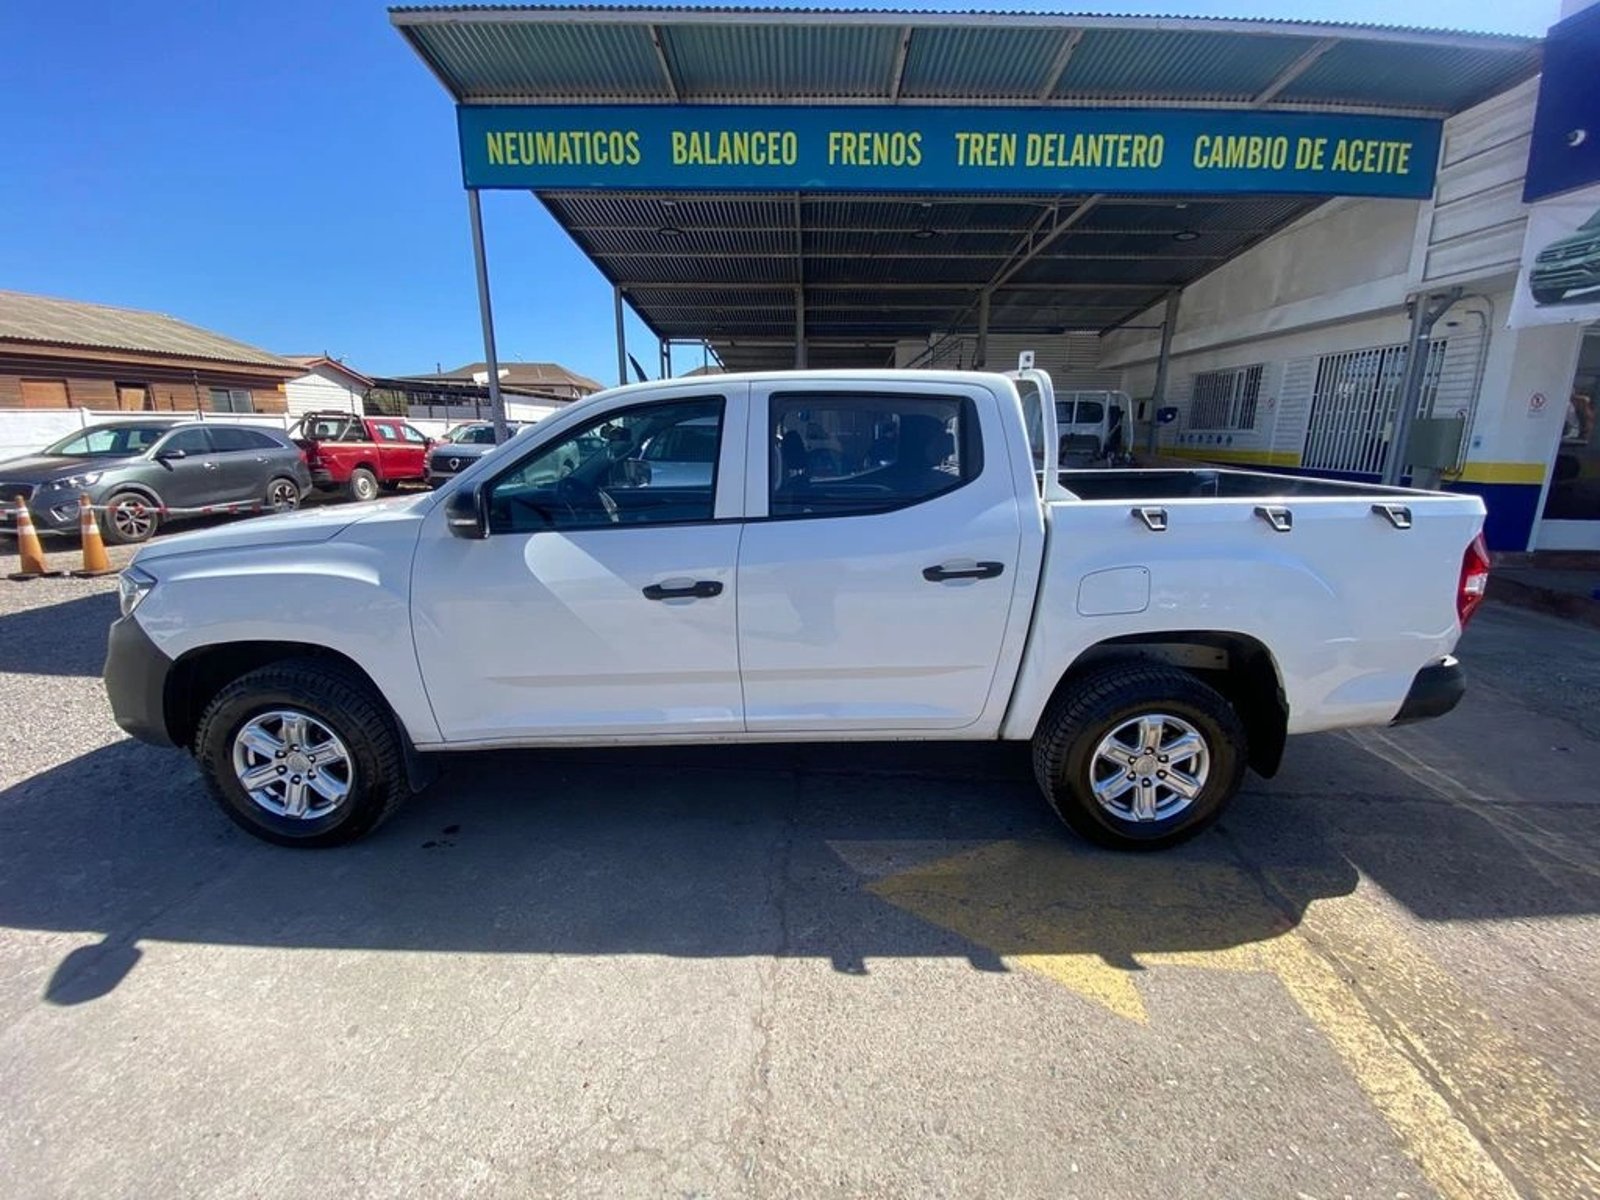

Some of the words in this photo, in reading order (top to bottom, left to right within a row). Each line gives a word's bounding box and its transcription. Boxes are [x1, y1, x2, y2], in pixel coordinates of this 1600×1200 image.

[486, 131, 641, 165] NEUMATICOS
[671, 131, 798, 165] BALANCEO
[828, 132, 922, 166] FRENOS
[955, 132, 1017, 166] TREN
[1026, 133, 1165, 168] DELANTERO
[1194, 135, 1289, 170] CAMBIO
[1295, 138, 1327, 170] DE
[1331, 140, 1412, 174] ACEITE
